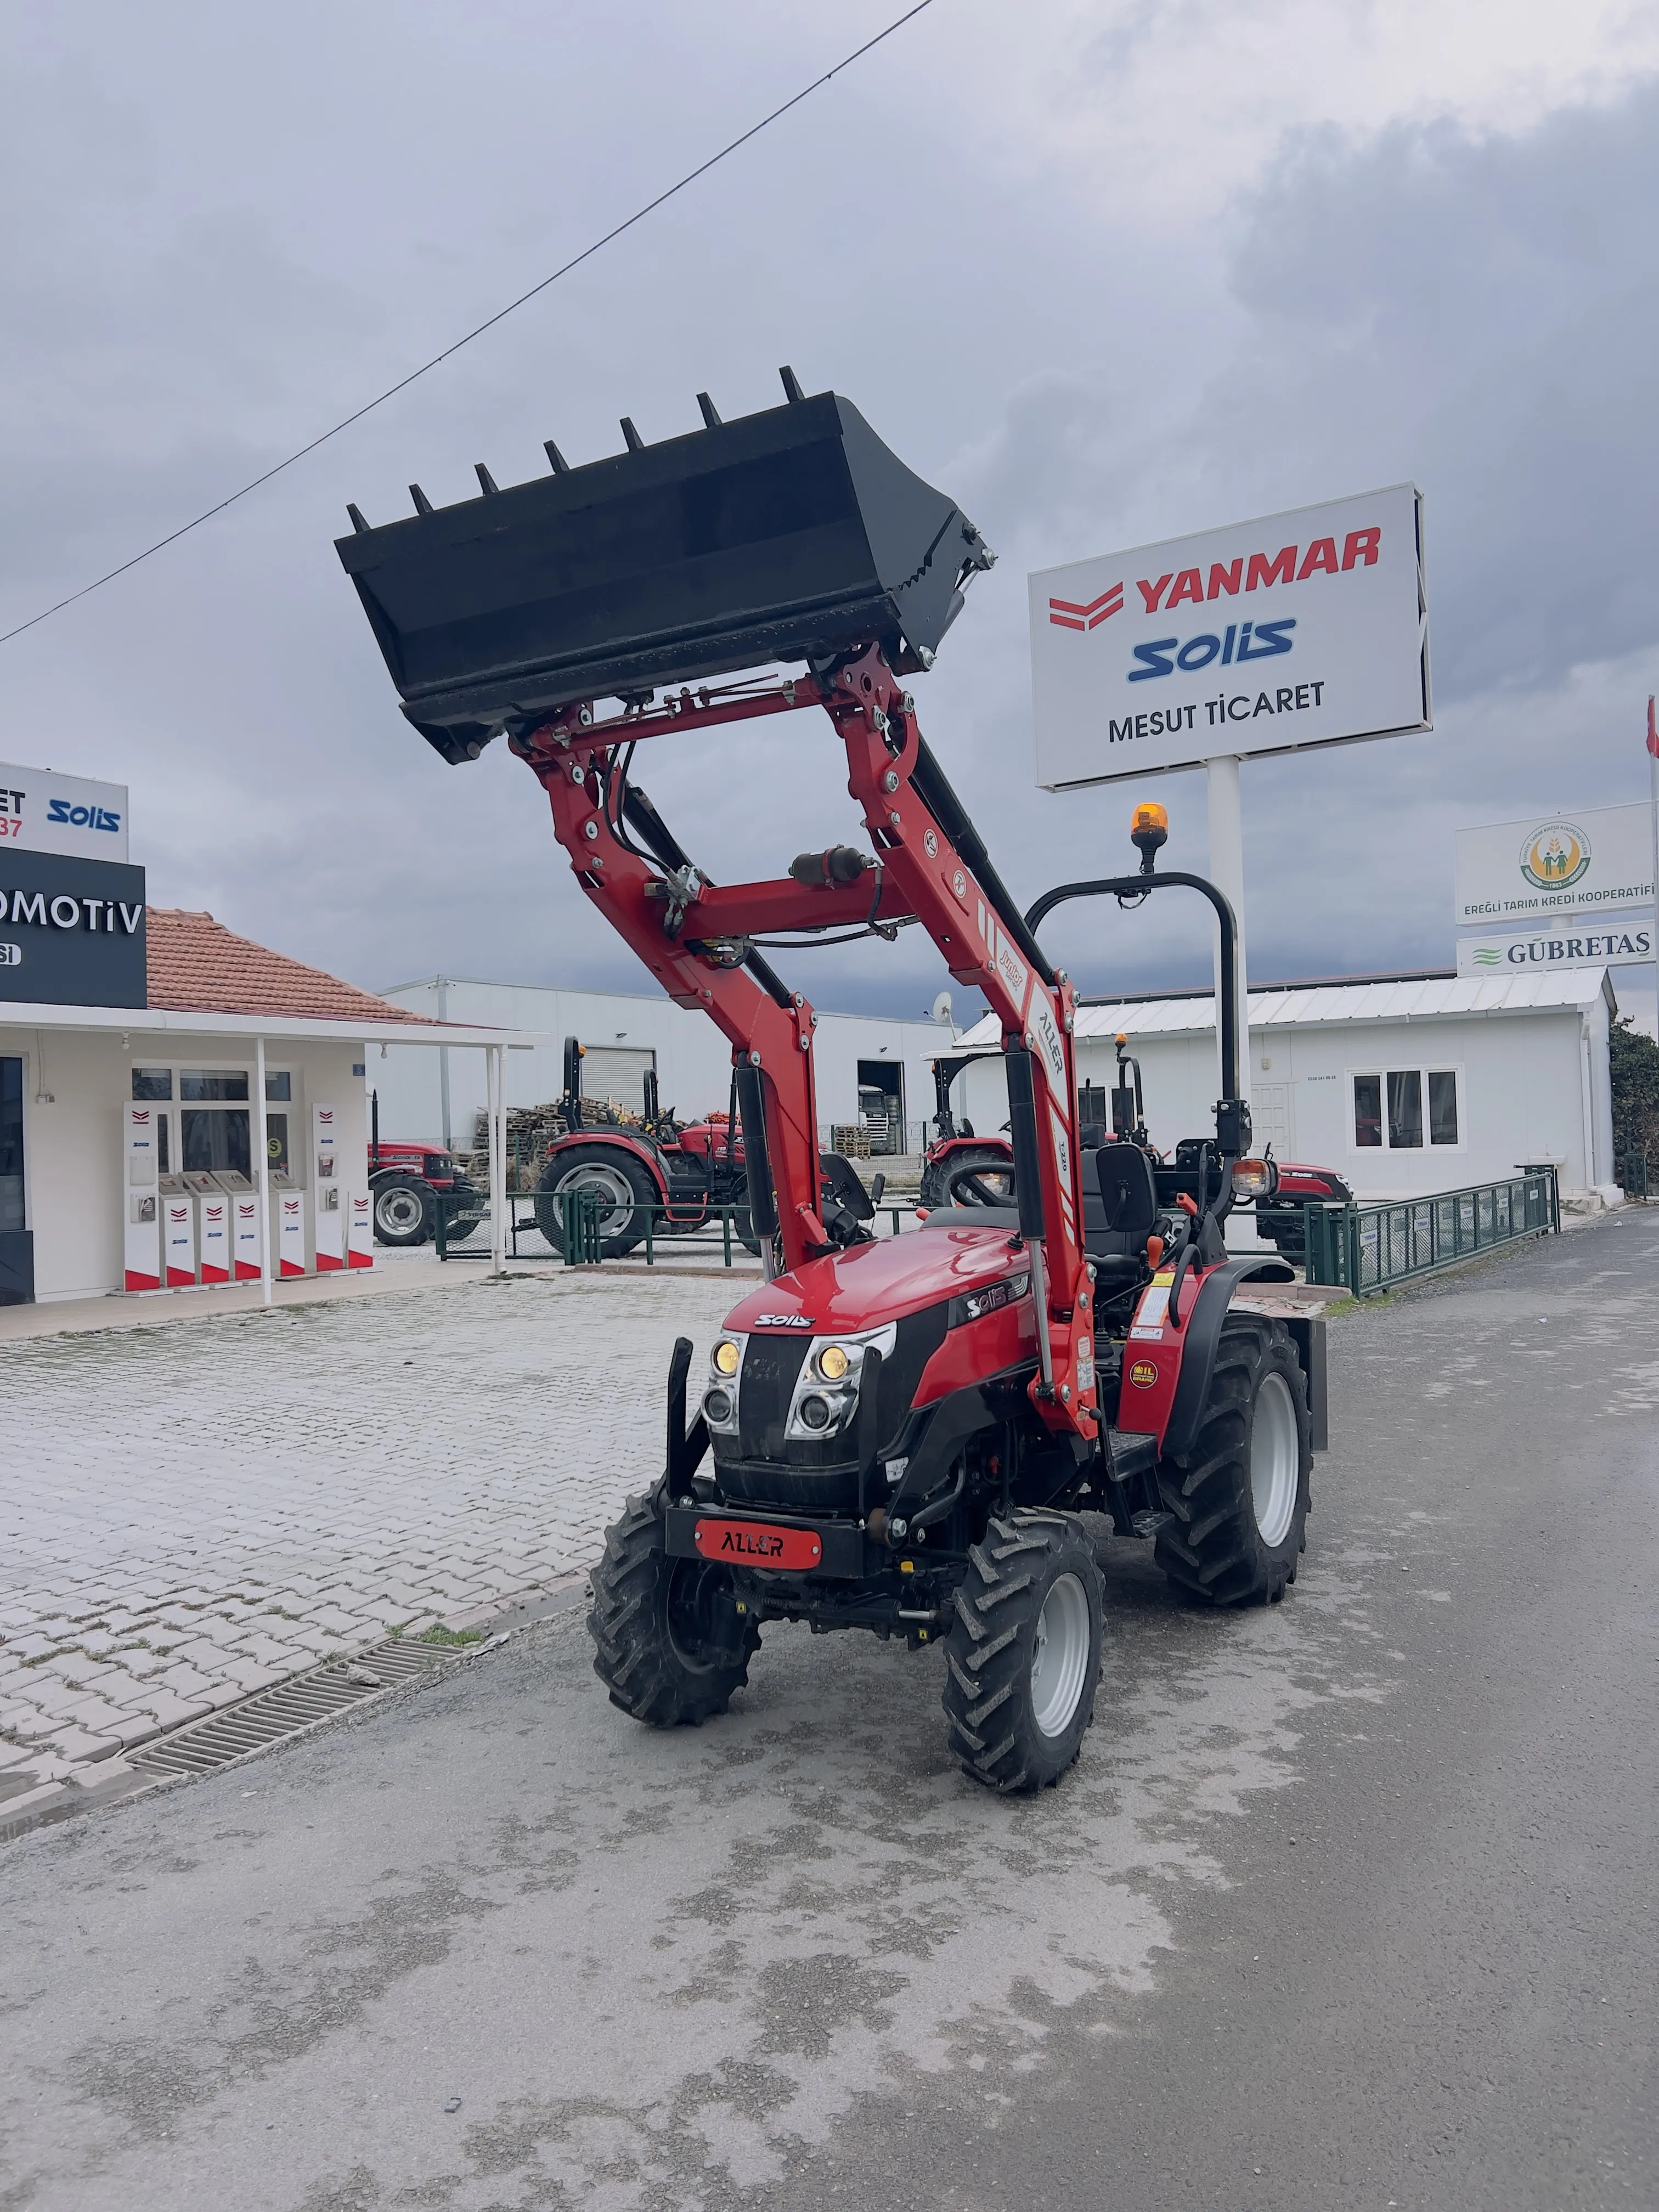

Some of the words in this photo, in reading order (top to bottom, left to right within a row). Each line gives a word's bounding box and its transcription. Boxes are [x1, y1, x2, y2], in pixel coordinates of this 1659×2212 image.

[1136, 527, 1381, 614] YANMAR
[1109, 705, 1196, 743] MESUT
[1205, 681, 1325, 725] TİCARET
[1464, 900, 1501, 915] EREĞLİ
[1504, 898, 1538, 911] TARIM
[1542, 892, 1575, 906] KREDİ
[1040, 1012, 1063, 1075] ALLER
[1134, 1365, 1154, 1375] OIL
[720, 1531, 783, 1558] ALLER
